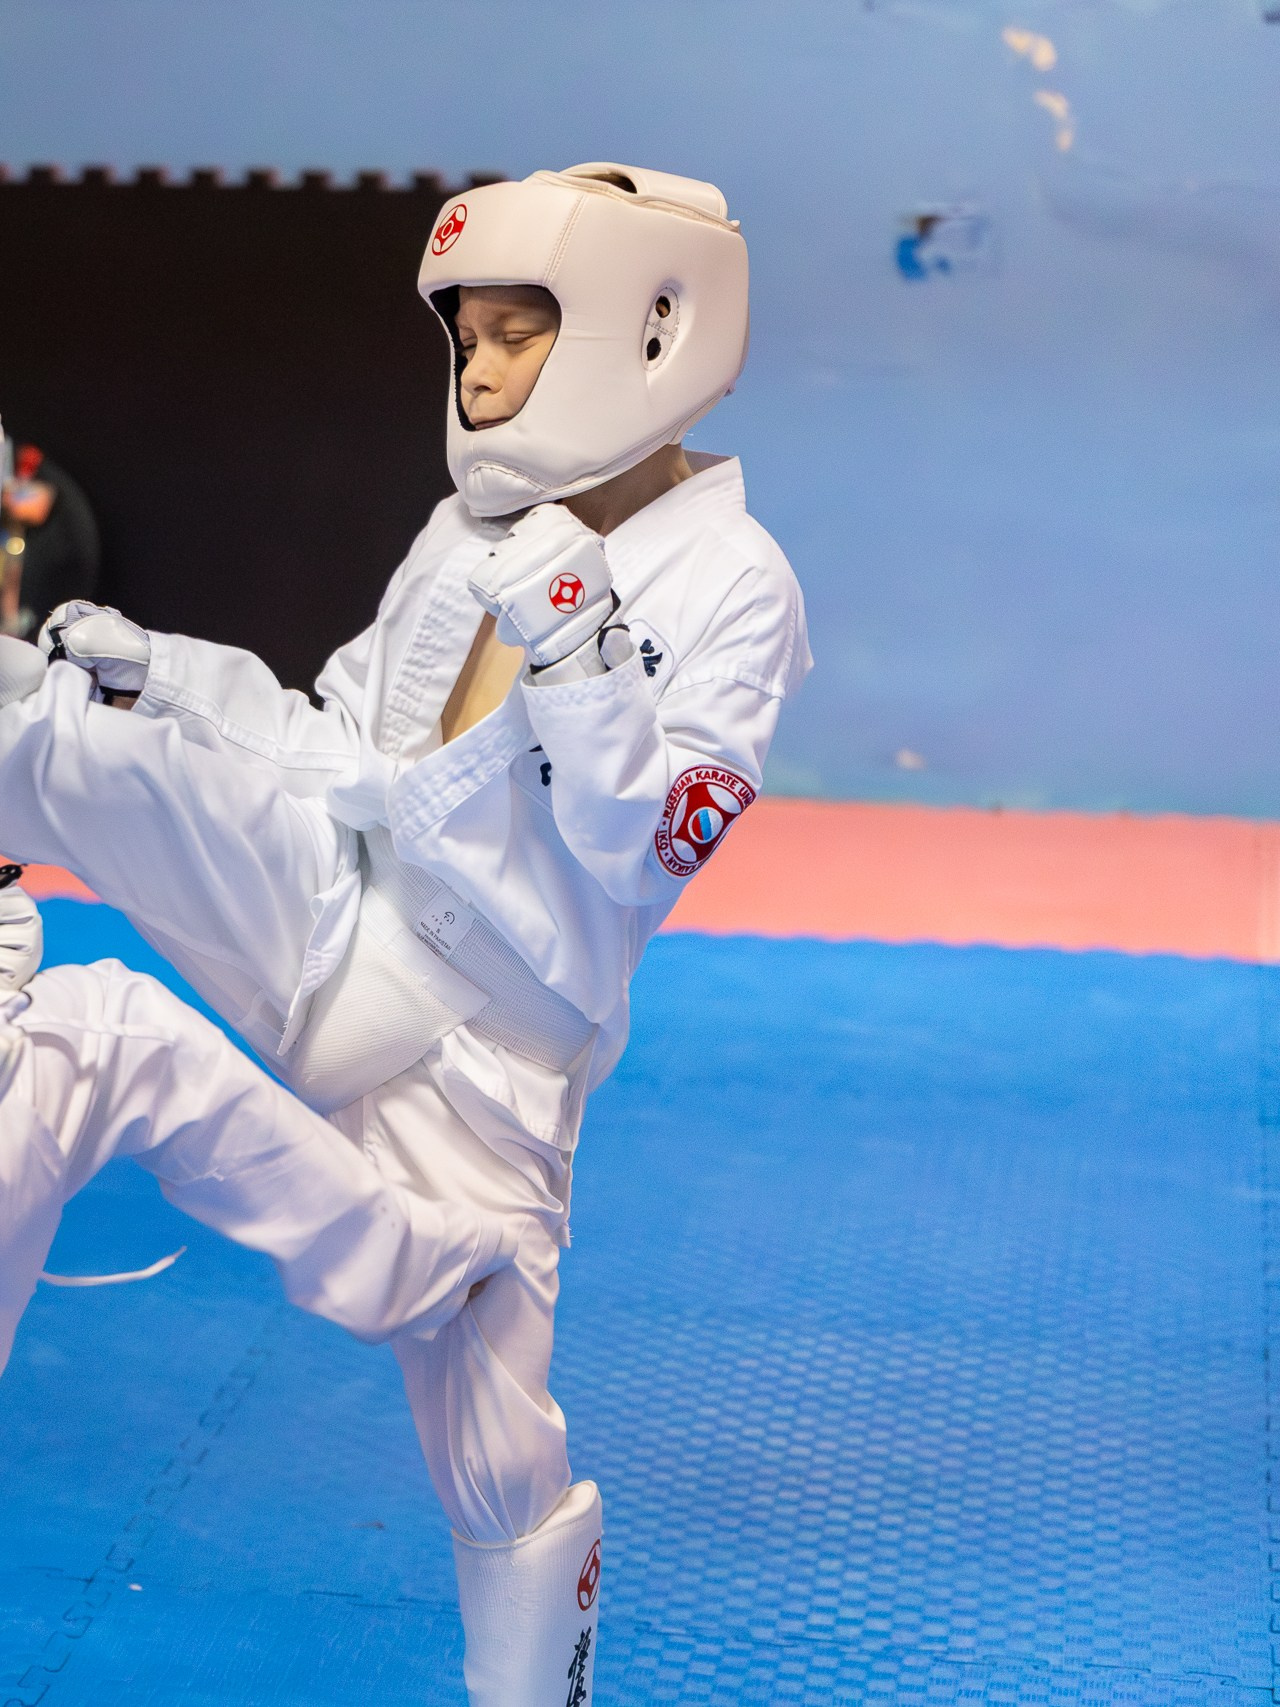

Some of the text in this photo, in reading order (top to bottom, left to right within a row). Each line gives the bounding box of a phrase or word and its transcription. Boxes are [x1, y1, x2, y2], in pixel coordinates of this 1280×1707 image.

[658, 830, 668, 850] IKO
[663, 775, 693, 819] RUSSIAN
[696, 771, 738, 789] KARATE
